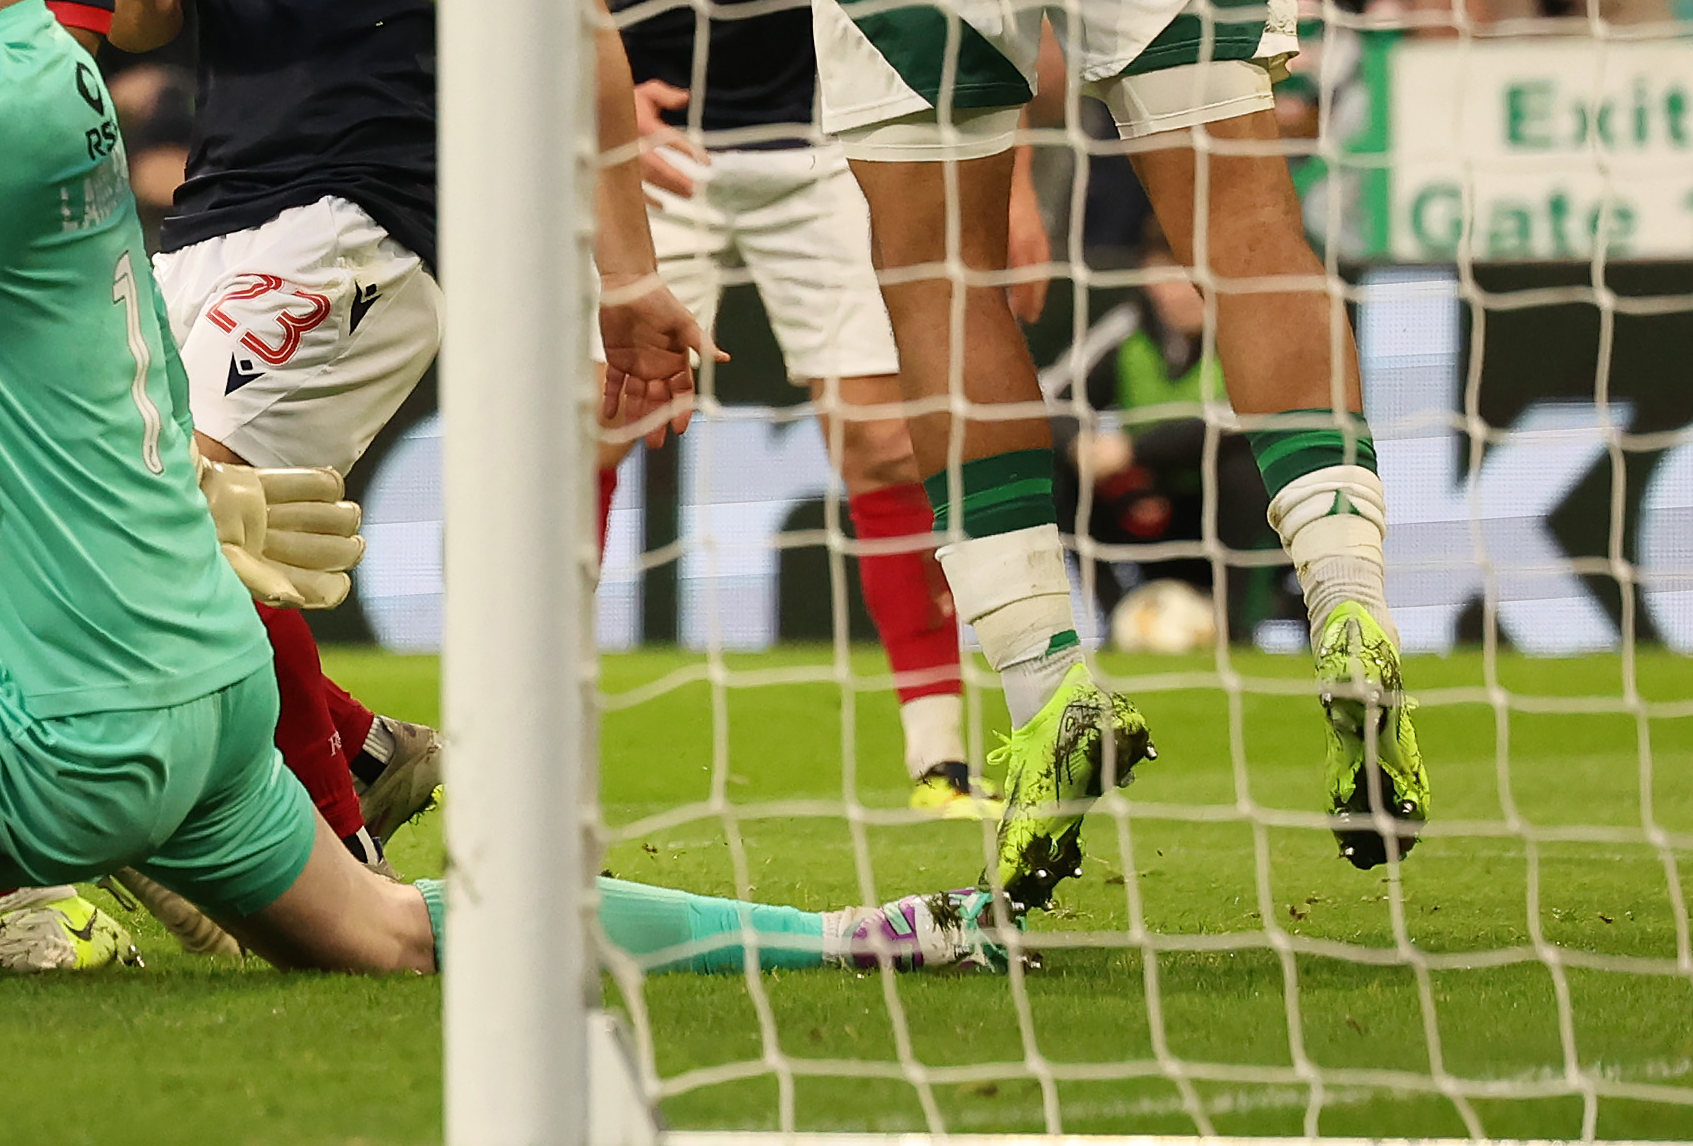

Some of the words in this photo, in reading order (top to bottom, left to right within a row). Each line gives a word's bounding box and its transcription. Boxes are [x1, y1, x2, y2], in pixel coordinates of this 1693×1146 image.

[85, 120, 119, 162] RS
[1504, 78, 1693, 151] Exit
[1410, 180, 1638, 259] Gate
[204, 272, 333, 366] 23
[112, 249, 165, 476] 1
